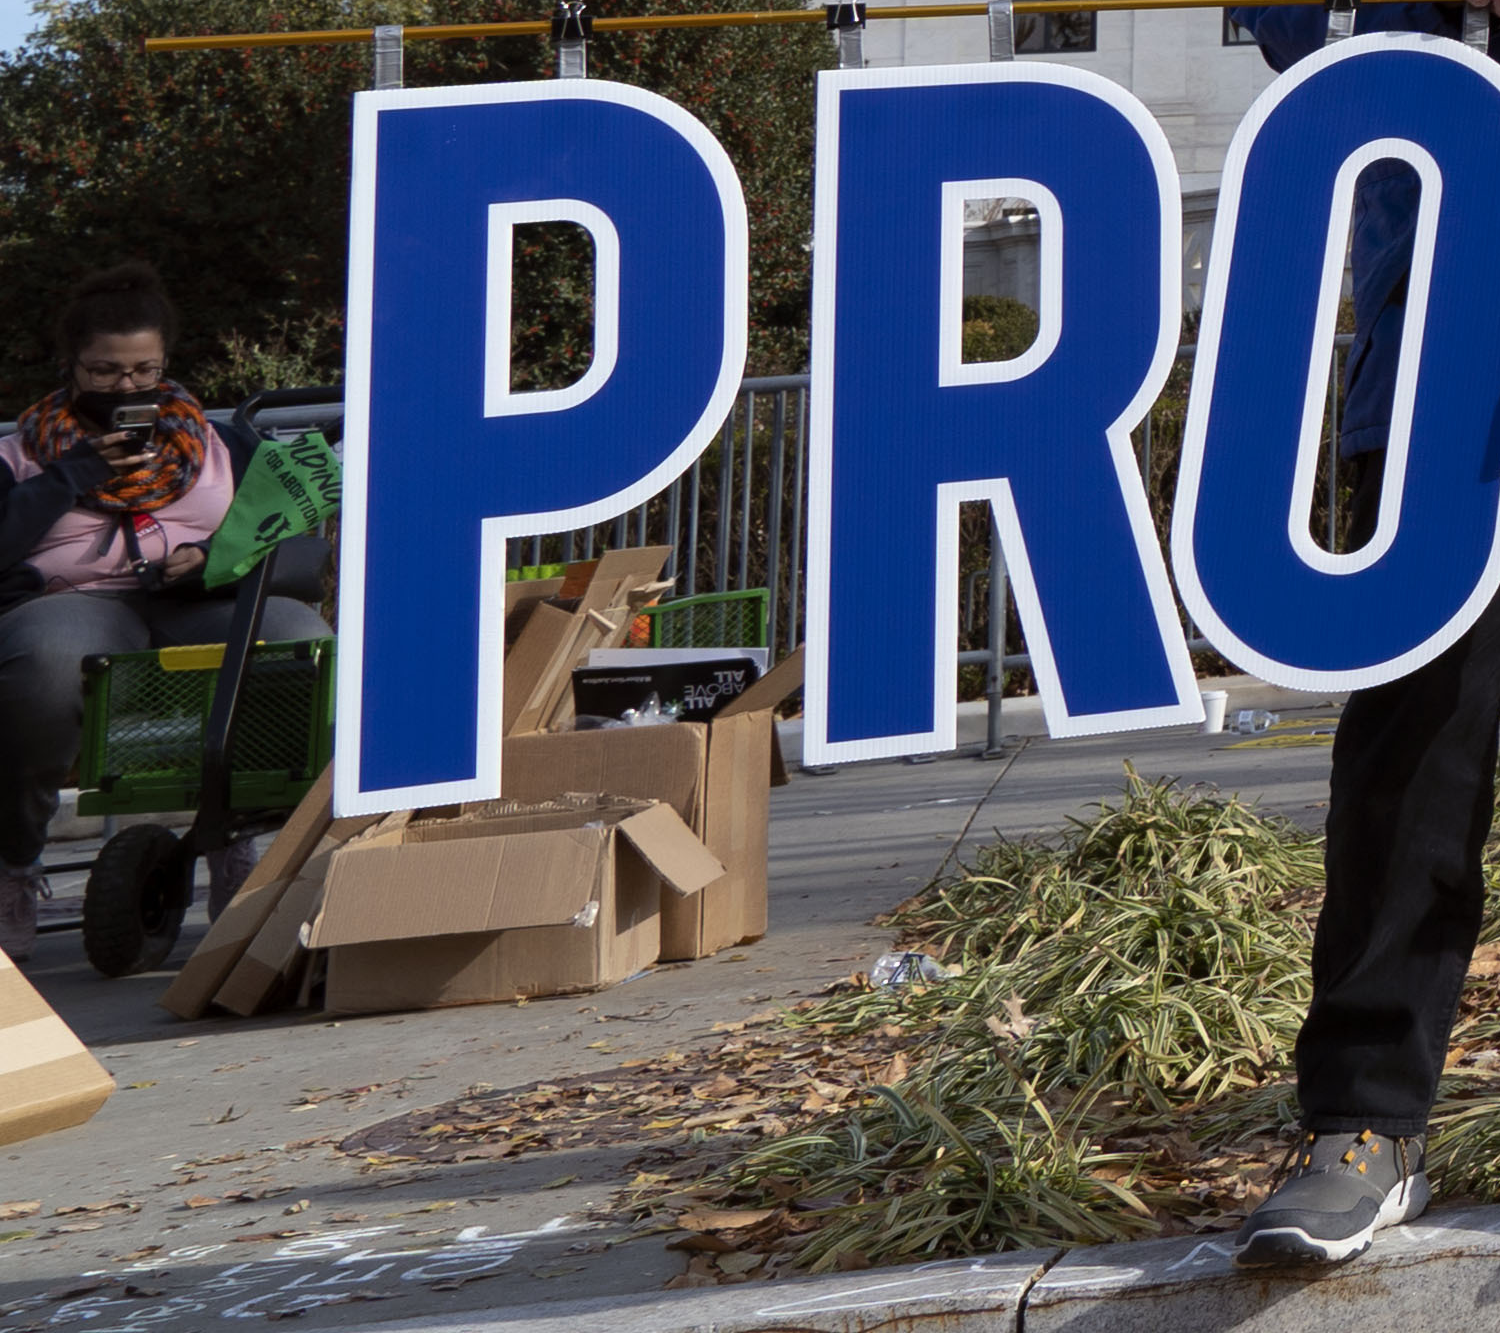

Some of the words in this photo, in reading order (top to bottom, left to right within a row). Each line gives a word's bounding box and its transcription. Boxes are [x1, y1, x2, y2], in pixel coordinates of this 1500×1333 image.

[264, 449, 285, 473] FOR
[276, 470, 320, 528] ABORTION
[713, 670, 746, 683] ALL
[683, 683, 747, 697] ABOVE
[683, 696, 716, 710] ALL
